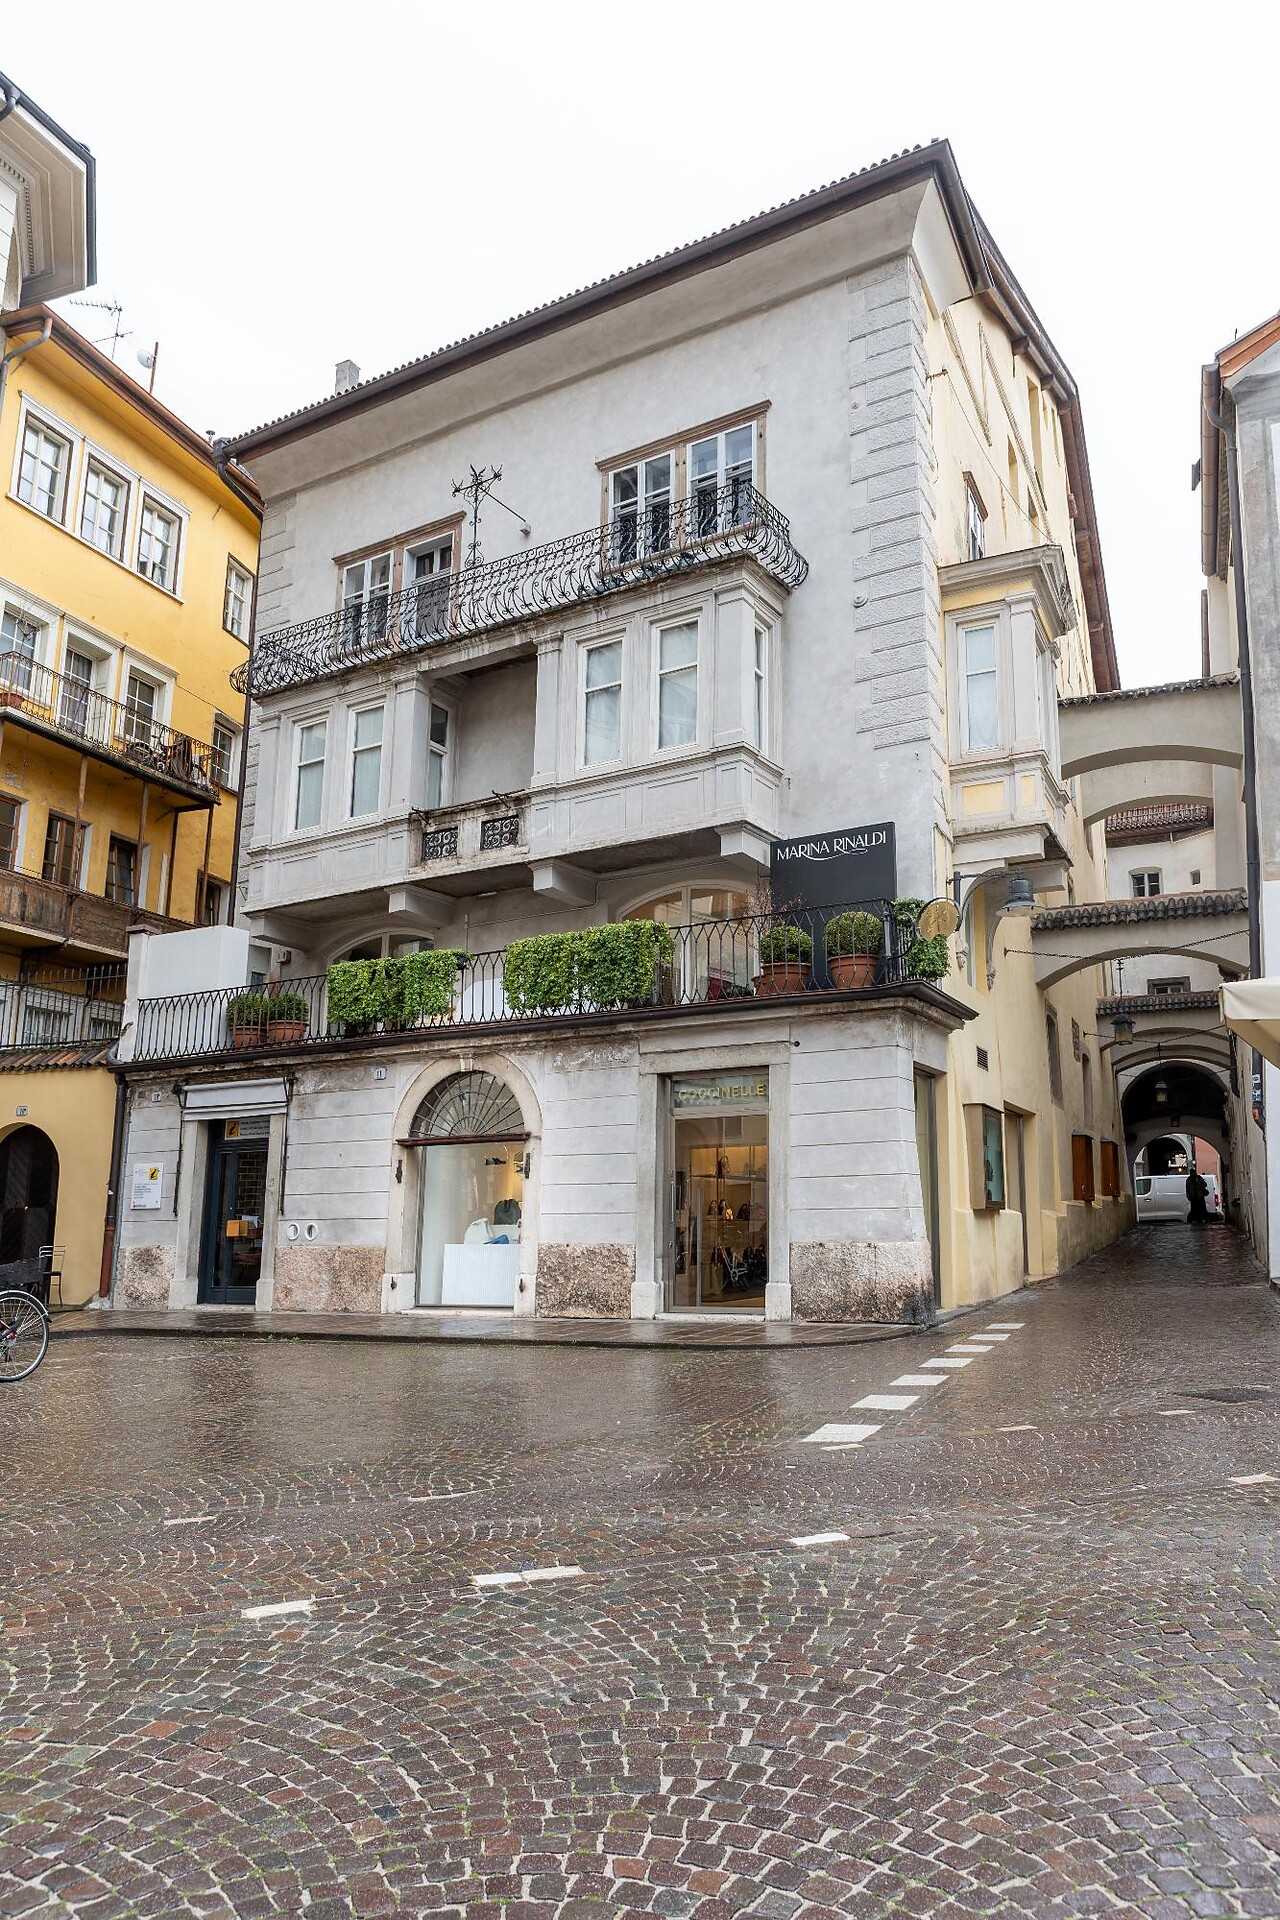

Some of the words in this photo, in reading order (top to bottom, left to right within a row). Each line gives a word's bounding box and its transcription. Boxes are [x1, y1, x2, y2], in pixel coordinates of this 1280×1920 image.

[777, 840, 830, 861] MARINA
[834, 830, 887, 853] RINALDI
[678, 1084, 767, 1101] COCCINELLE
